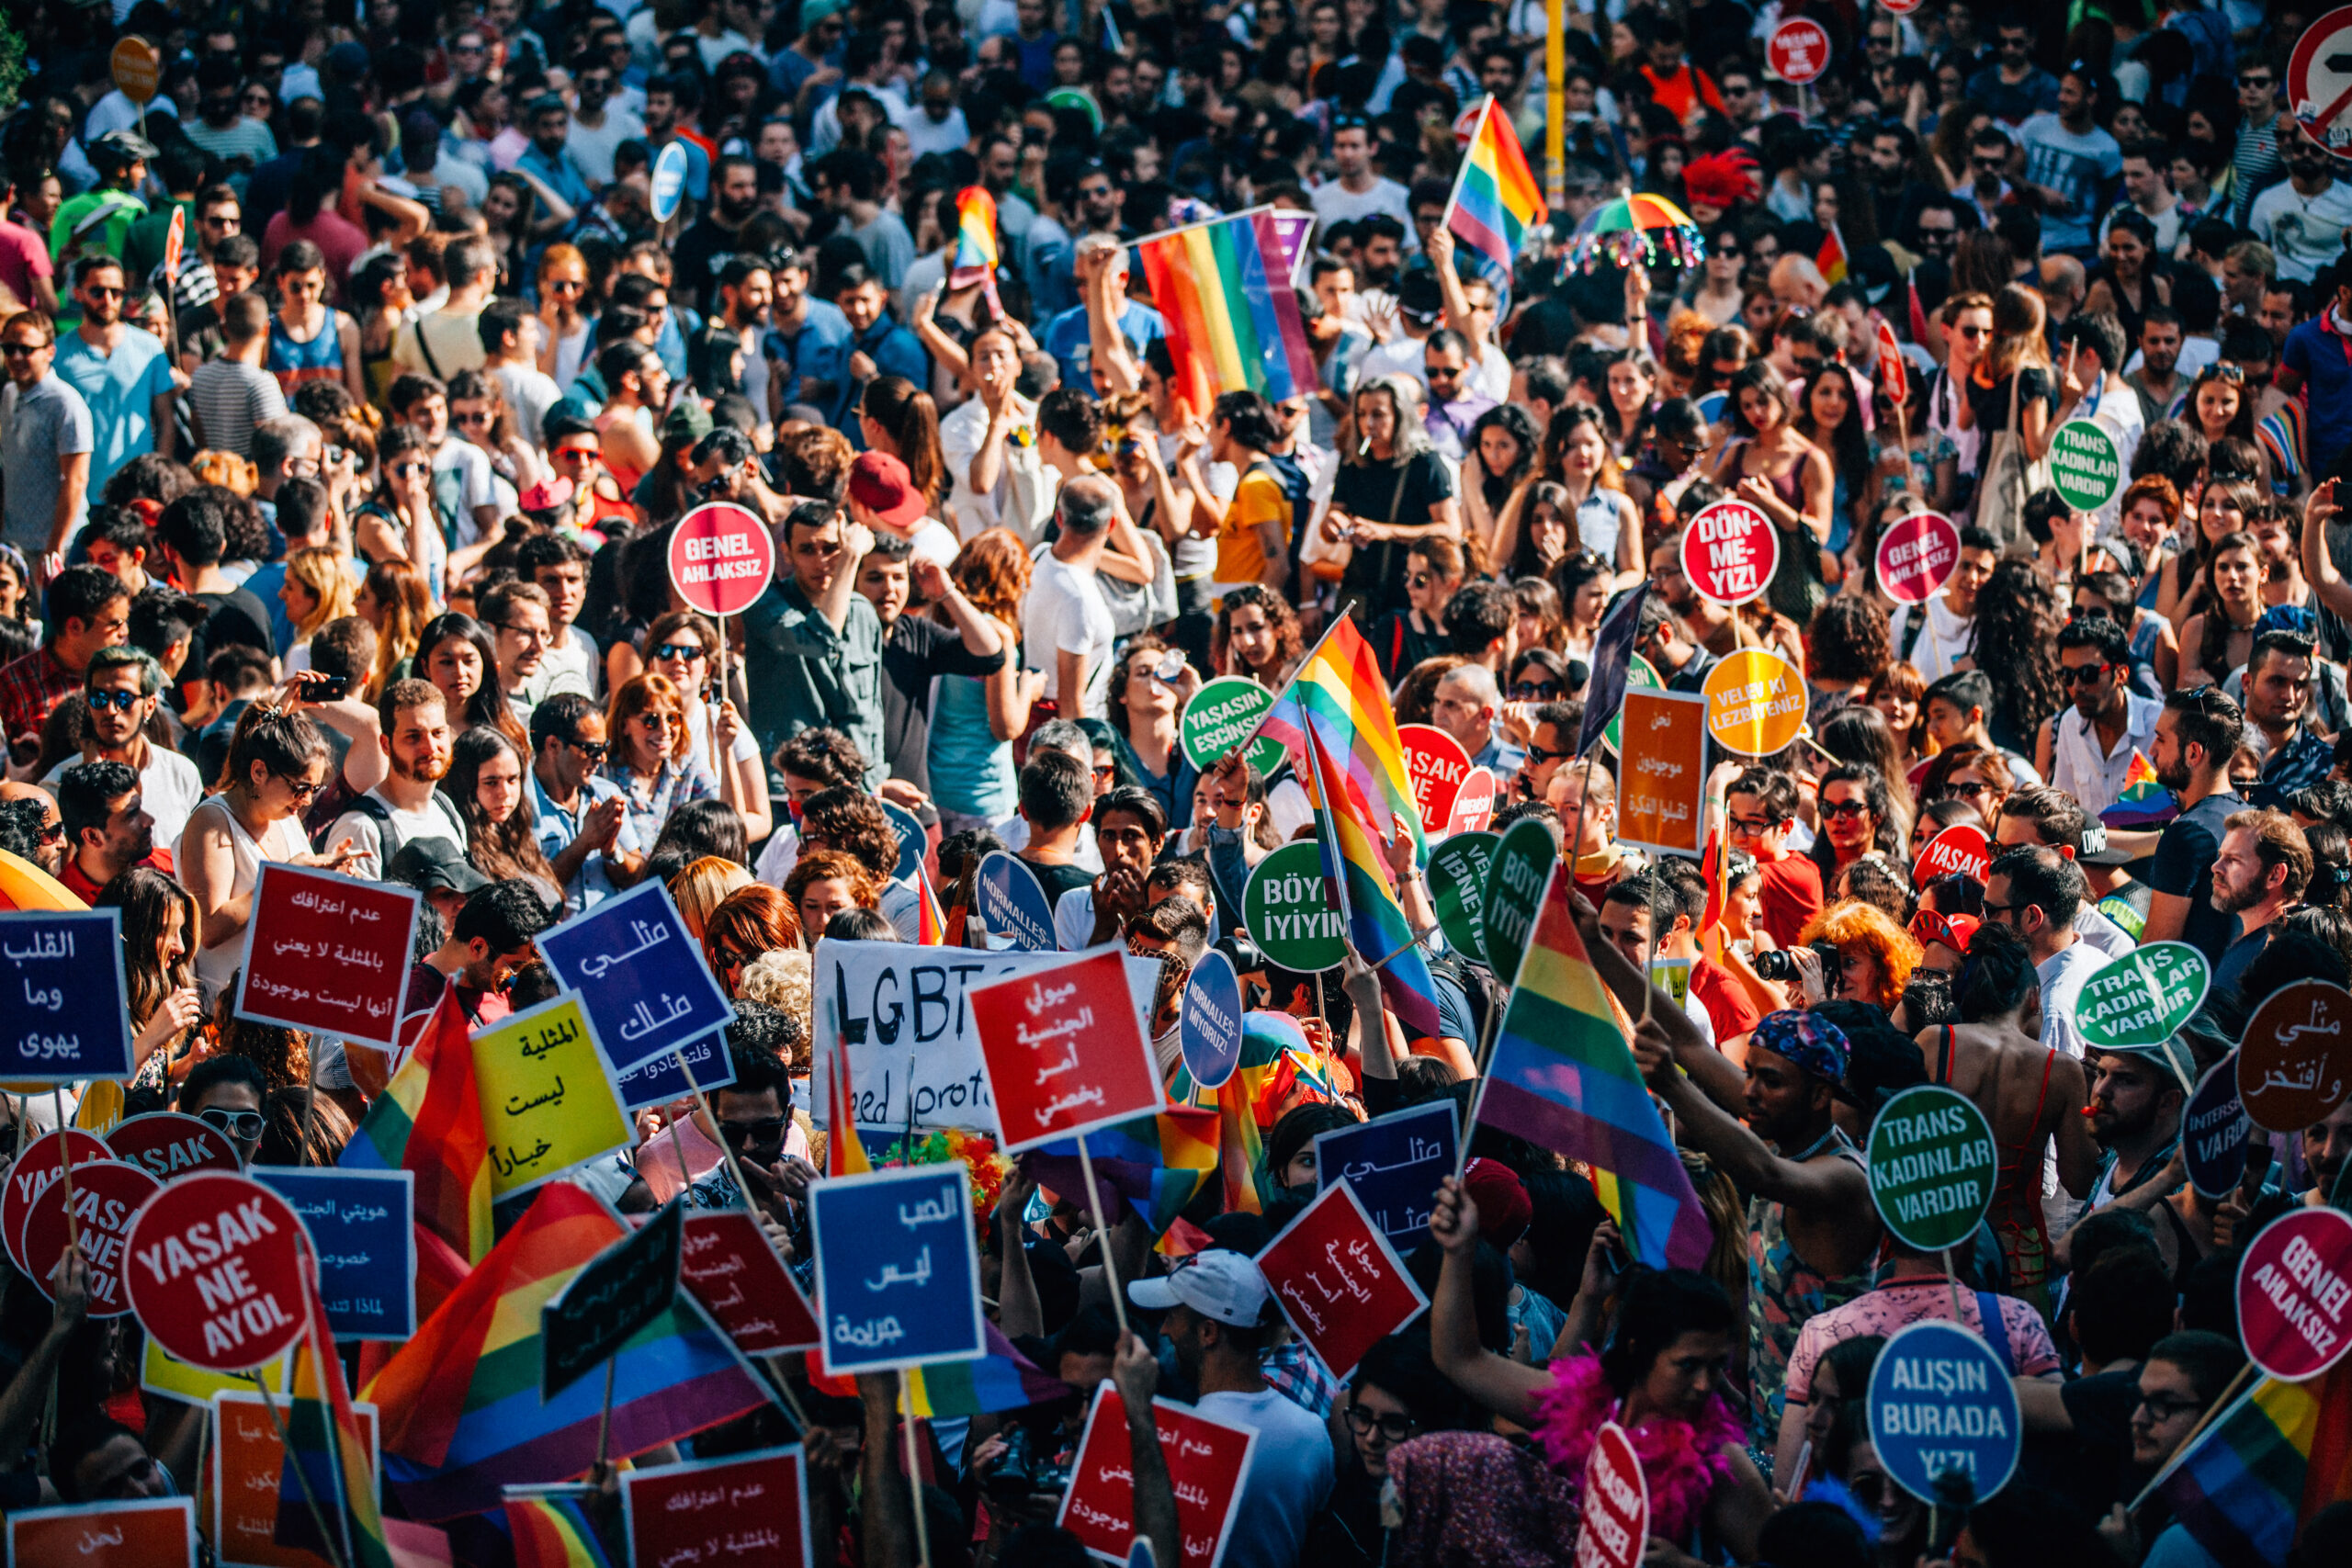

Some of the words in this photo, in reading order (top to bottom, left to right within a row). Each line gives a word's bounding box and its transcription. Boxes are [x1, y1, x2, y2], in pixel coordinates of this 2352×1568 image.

[2063, 428, 2108, 455] TRANS
[2051, 446, 2118, 479] KADINLAR
[2059, 470, 2107, 498] VARDIR
[1698, 509, 1760, 544] DÖN-
[684, 533, 754, 561] GENEL
[1709, 538, 1756, 569] ME-
[1888, 530, 1944, 567] GENEL
[682, 558, 763, 584] AHLAKSIZ
[1888, 547, 1951, 588] AHLAKSIZ
[1187, 689, 1263, 730] YAŞASIN
[1713, 694, 1803, 731] LEZBİYENİZ
[1716, 681, 1764, 707] VELEV
[1193, 710, 1267, 753] EŞCİNSE
[1651, 712, 1671, 730] نحن
[1403, 746, 1465, 785] ASAK
[1636, 751, 1683, 778] موجودون
[1501, 849, 1543, 908] BÖYL
[1929, 840, 1988, 879] YASAK
[291, 890, 345, 914] اعترافك
[1263, 873, 1326, 905] BÖY
[349, 905, 381, 925] عدم
[982, 873, 1053, 946] NORMALLEŞ-
[4, 931, 75, 969] القلب
[273, 938, 311, 958] يعني
[316, 942, 329, 956] لا
[334, 944, 384, 973] بالمثلية
[580, 919, 671, 978] مثلي
[251, 973, 310, 1001] موجودة
[2086, 948, 2174, 998] TRANS
[24, 977, 63, 1011] وما
[315, 989, 362, 1012] ليست
[365, 998, 393, 1018] أنها
[1025, 980, 1077, 1014] ميولي
[1189, 978, 1238, 1040] NORMALLEŞ-
[2076, 957, 2202, 1030] KADINLAR
[2100, 986, 2194, 1038] VARDIR
[520, 1019, 579, 1060] المثلية
[1016, 1005, 1094, 1047] الجنسية
[1188, 1005, 1228, 1055] MİYORUZ!
[2275, 998, 2342, 1046] مثلي
[18, 1032, 82, 1060] يهوى
[1035, 1042, 1080, 1086] أمر
[505, 1075, 565, 1117] ليست
[2246, 1052, 2342, 1103] وأفتخر
[851, 1069, 890, 1124] eed
[915, 1068, 992, 1127] prot
[1035, 1081, 1106, 1127] يخصني
[1882, 1105, 1967, 1148] TRANS
[117, 1133, 215, 1178] ASAK
[1343, 1136, 1442, 1182] مثلي
[1871, 1138, 1992, 1191] KADINLAR
[62, 1187, 140, 1235] YASA
[341, 1202, 389, 1224] هويتي
[899, 1184, 958, 1232] الحب
[1894, 1179, 1981, 1224] VARDIR
[79, 1228, 126, 1270] NE
[136, 1196, 277, 1285] YASAK
[1348, 1239, 1381, 1280] ميولي
[194, 1256, 258, 1312] NE
[865, 1244, 933, 1292] ليس
[1305, 1270, 1343, 1304] أمر
[1325, 1239, 1373, 1304] الجنسية
[2281, 1235, 2352, 1325] GENEL
[202, 1292, 294, 1358] AYOL
[356, 1298, 384, 1316] لماذا
[1282, 1279, 1327, 1337] يخصني
[2252, 1262, 2338, 1358] AHLAKSIZ
[832, 1314, 907, 1347] جريمة
[1892, 1357, 1988, 1397] ALIŞIN
[1882, 1402, 2008, 1438] BURADA
[1181, 1437, 1214, 1458] عدم
[665, 1485, 726, 1511] اعترافك
[730, 1483, 765, 1507] عدم
[1071, 1496, 1130, 1532] موجودة
[76, 1525, 124, 1554] نحن
[706, 1536, 719, 1556] لا
[725, 1527, 780, 1557] بالمثلية
[1184, 1533, 1215, 1557] أنها
